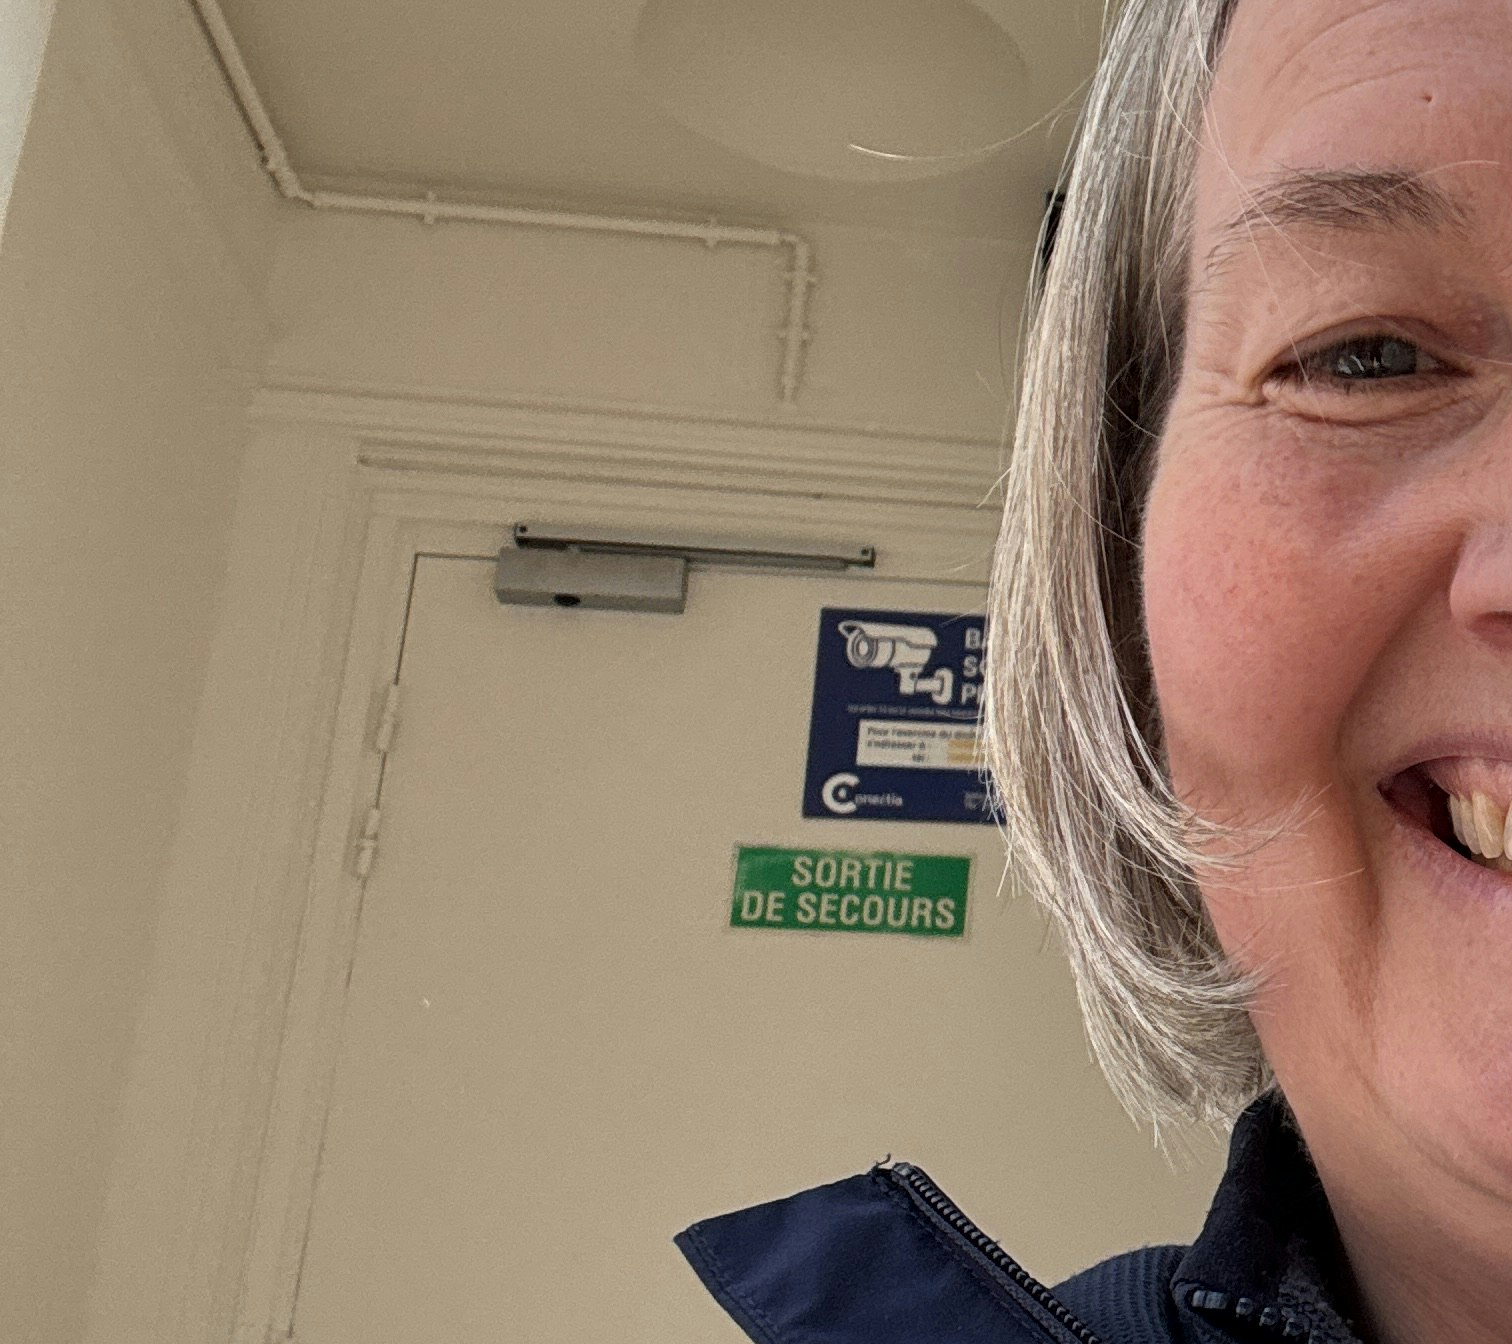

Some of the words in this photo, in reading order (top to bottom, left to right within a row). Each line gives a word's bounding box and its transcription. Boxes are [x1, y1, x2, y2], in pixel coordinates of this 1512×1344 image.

[791, 856, 914, 892] SORTIE
[740, 890, 785, 922] DE
[796, 892, 956, 930] SECOURS
